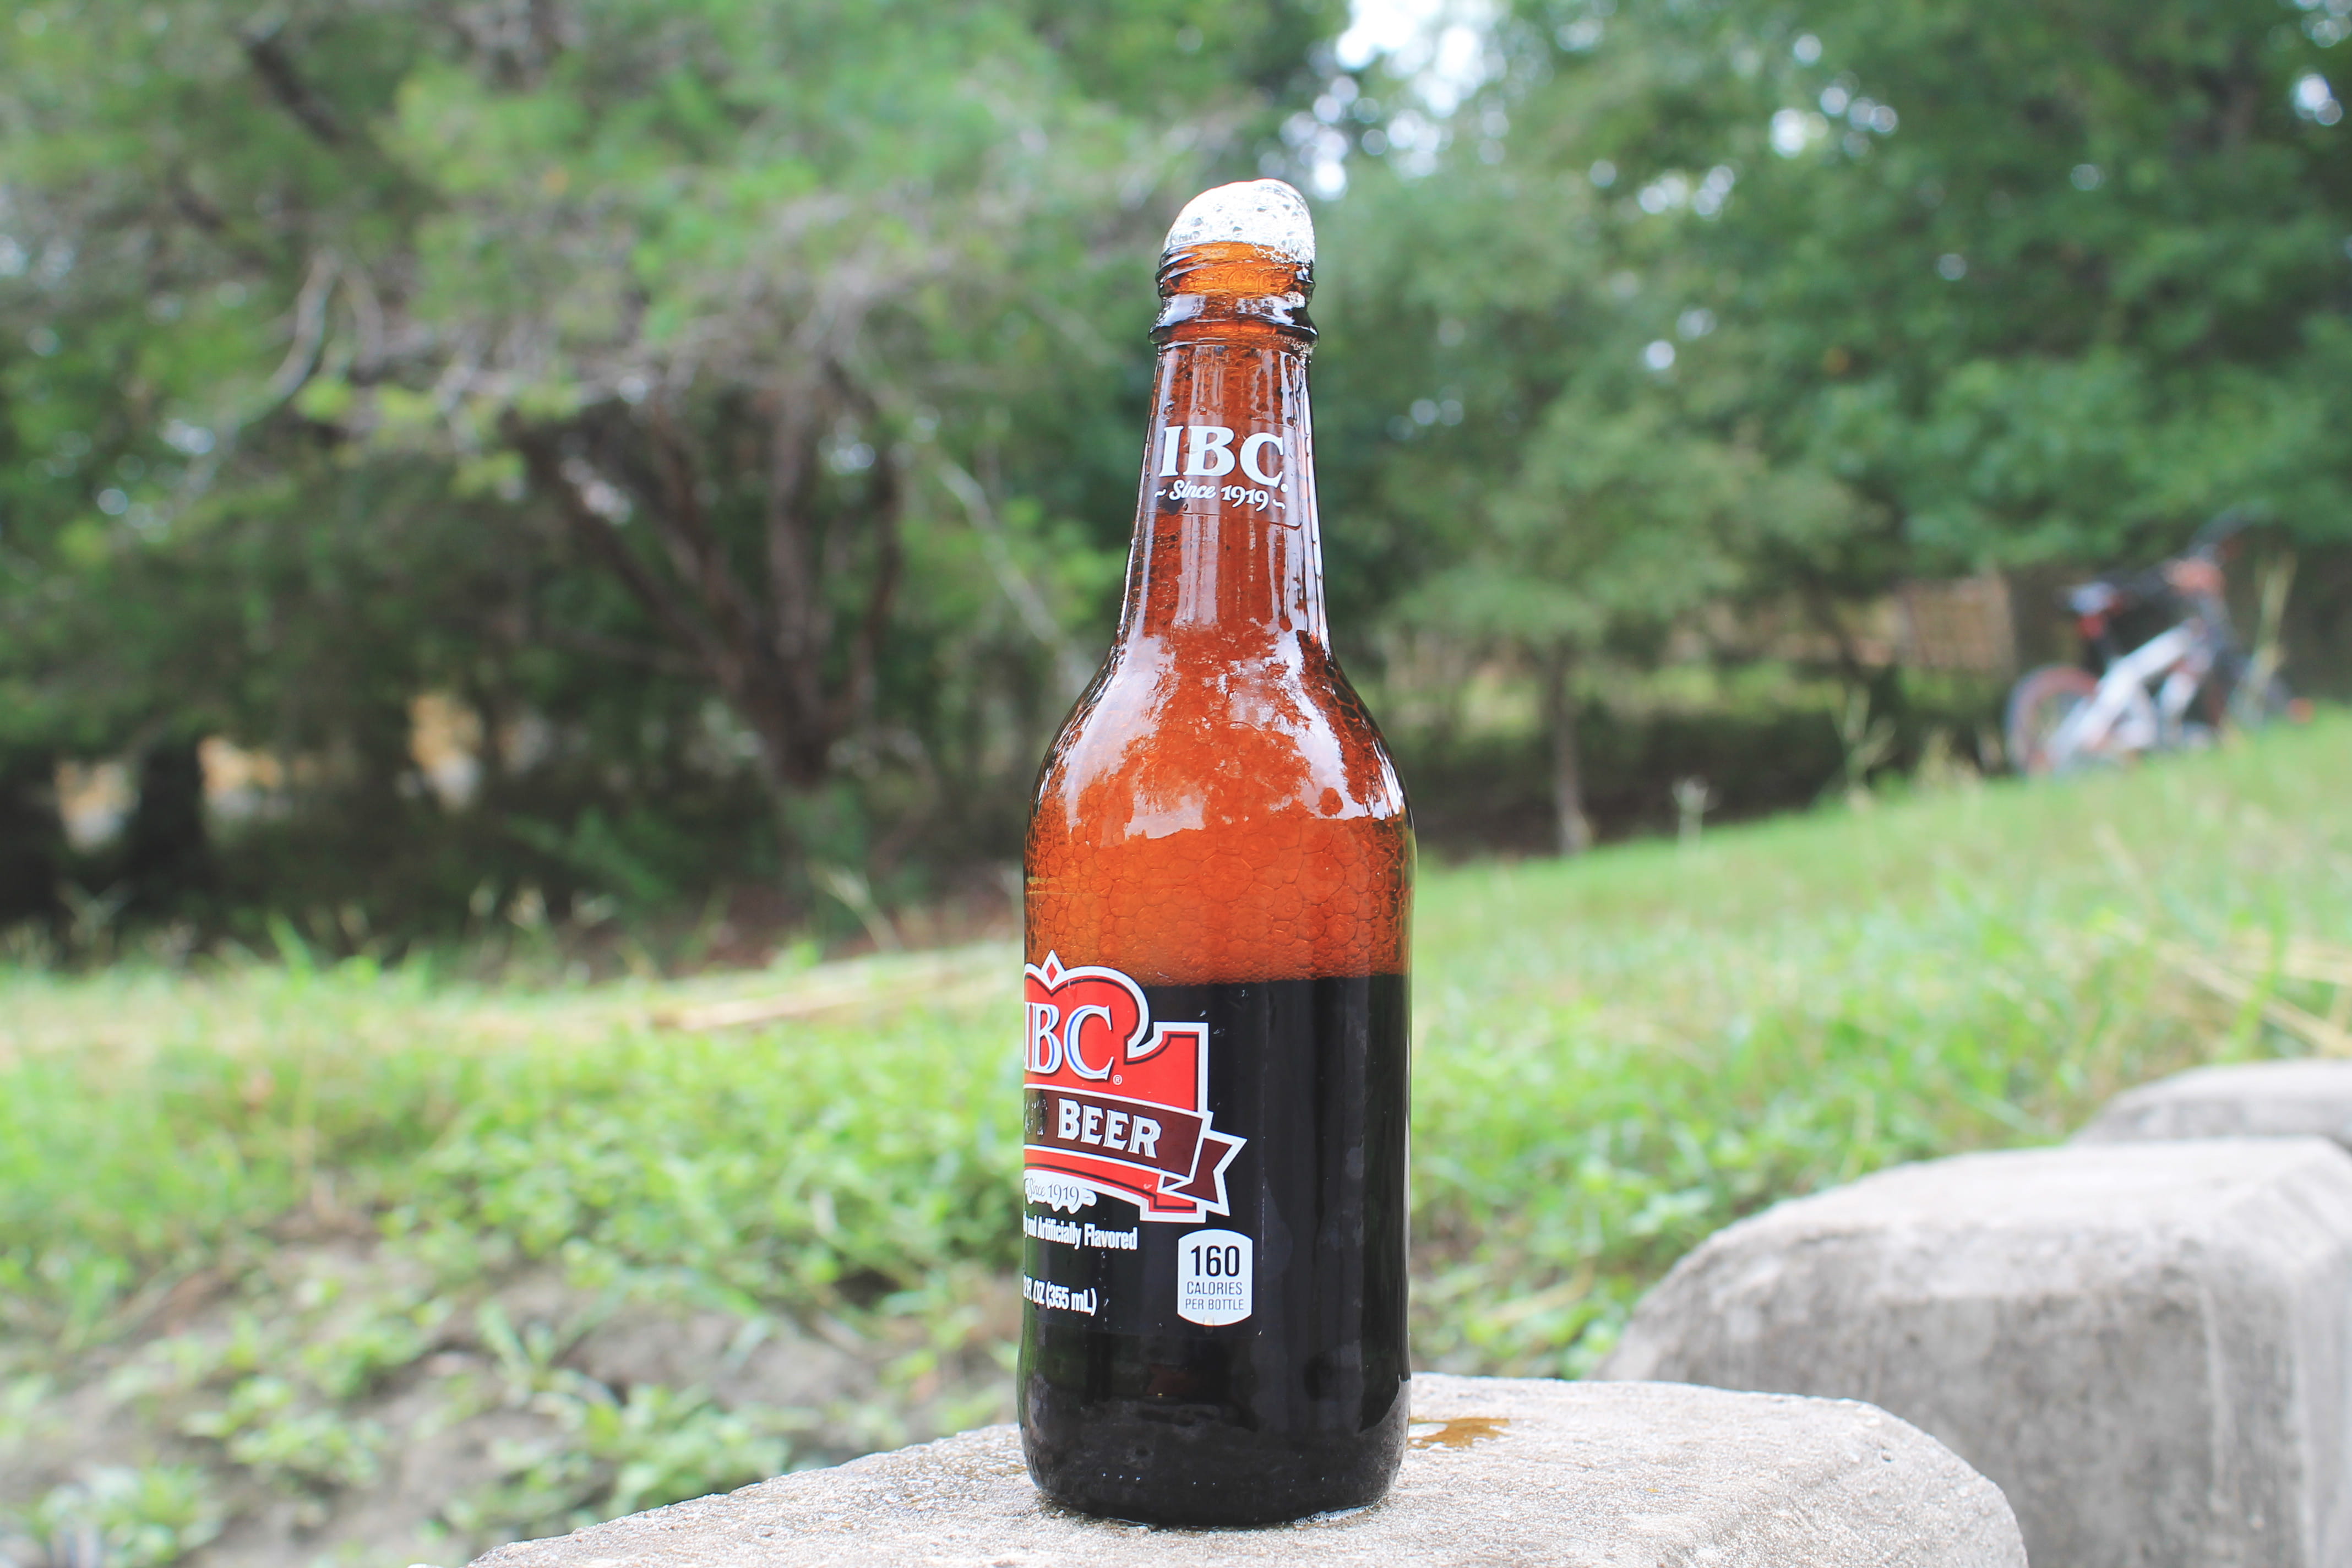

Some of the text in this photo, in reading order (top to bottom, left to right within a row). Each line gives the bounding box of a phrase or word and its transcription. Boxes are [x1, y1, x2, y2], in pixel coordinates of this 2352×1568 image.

[1158, 425, 1284, 488] IBC
[1168, 479, 1269, 511] Since 1919
[1057, 1098, 1162, 1159] BEER
[1048, 1184, 1080, 1207] 1919
[1037, 1216, 1082, 1250] Artificially
[1084, 1223, 1138, 1250] Flavored
[1190, 1245, 1240, 1277] 160
[1033, 1280, 1046, 1305] OZ
[1046, 1281, 1070, 1310] (355
[1071, 1287, 1097, 1316] mL)
[1185, 1298, 1244, 1310] PER BOTTLE
[1186, 1281, 1243, 1295] CALORIES
